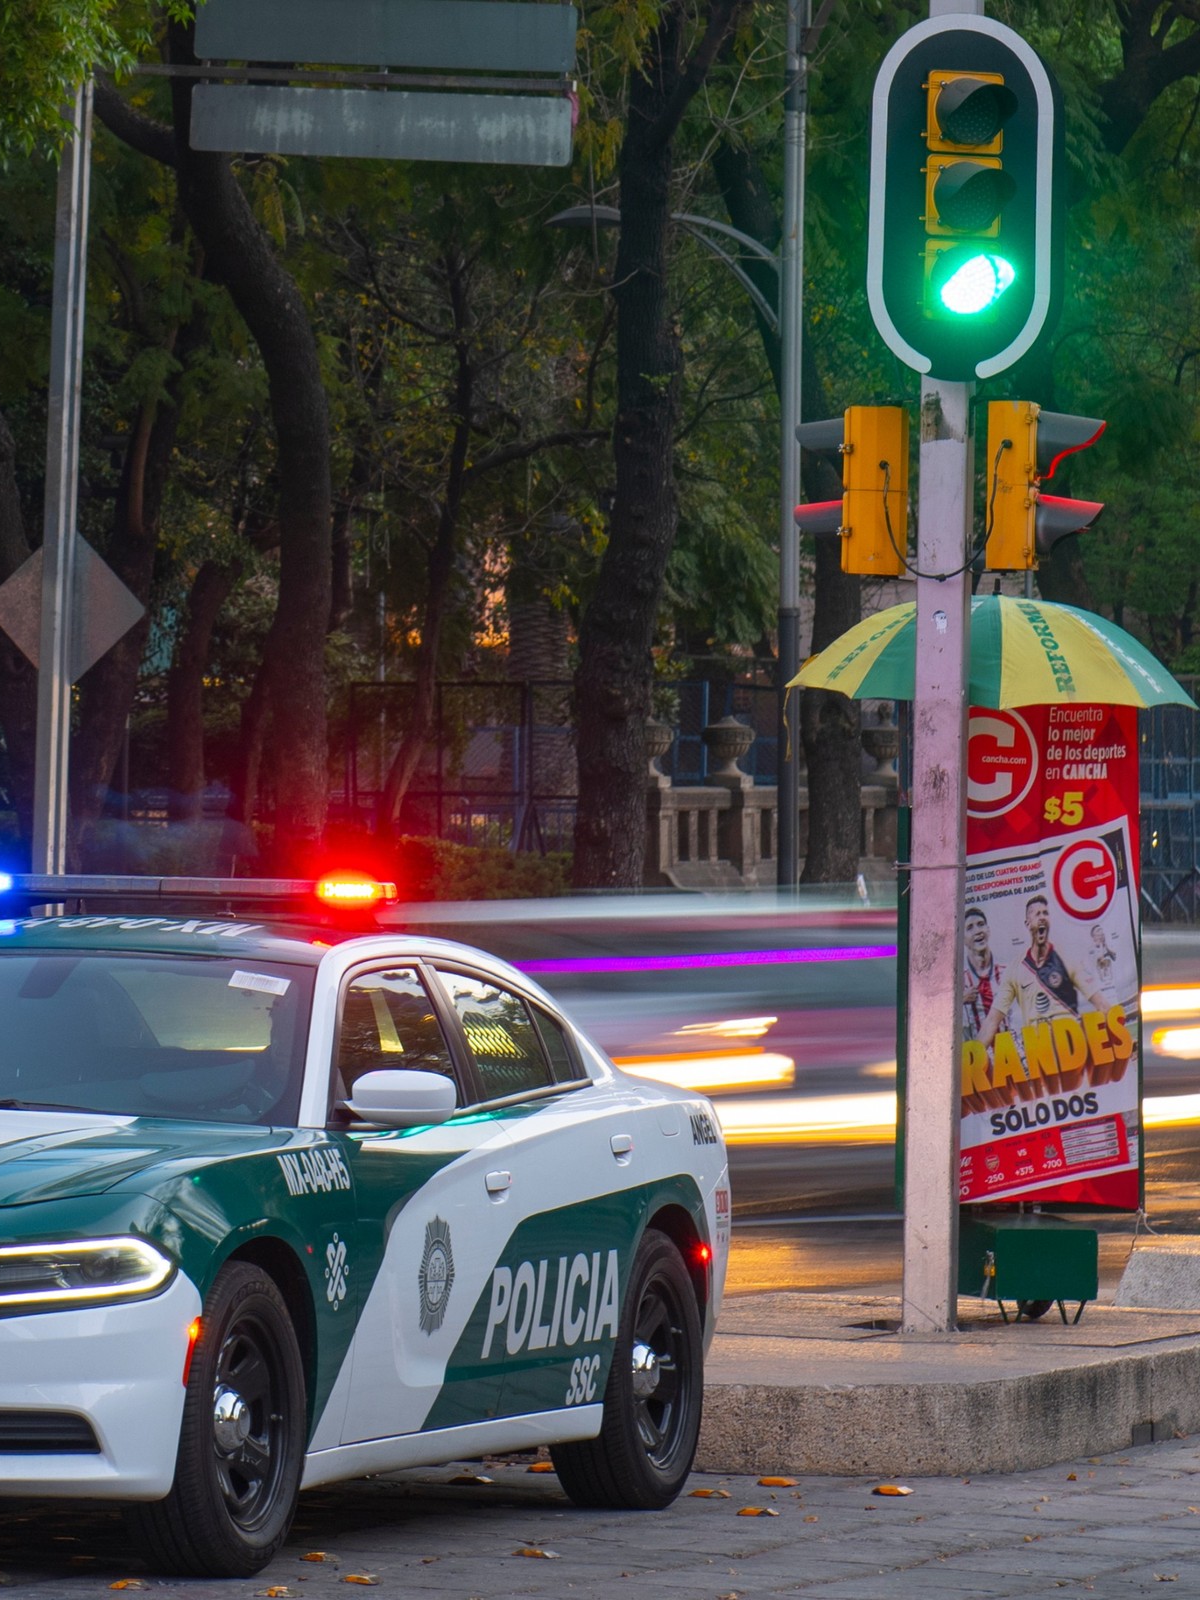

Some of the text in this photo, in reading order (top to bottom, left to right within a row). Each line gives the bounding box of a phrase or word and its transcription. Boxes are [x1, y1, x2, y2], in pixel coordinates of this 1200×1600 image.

[1049, 706, 1104, 723] Encuentra
[1048, 726, 1096, 744] lo mejor
[981, 755, 1027, 766] cancha.com
[1047, 743, 1127, 763] de los deportes
[1045, 763, 1108, 780] en CANCHA
[1043, 791, 1084, 826] $5
[989, 1091, 1099, 1136] SÓLO DOS
[276, 1148, 351, 1196] MX-048-H5
[480, 1248, 619, 1360] POLICIA
[565, 1353, 601, 1406] SSC
